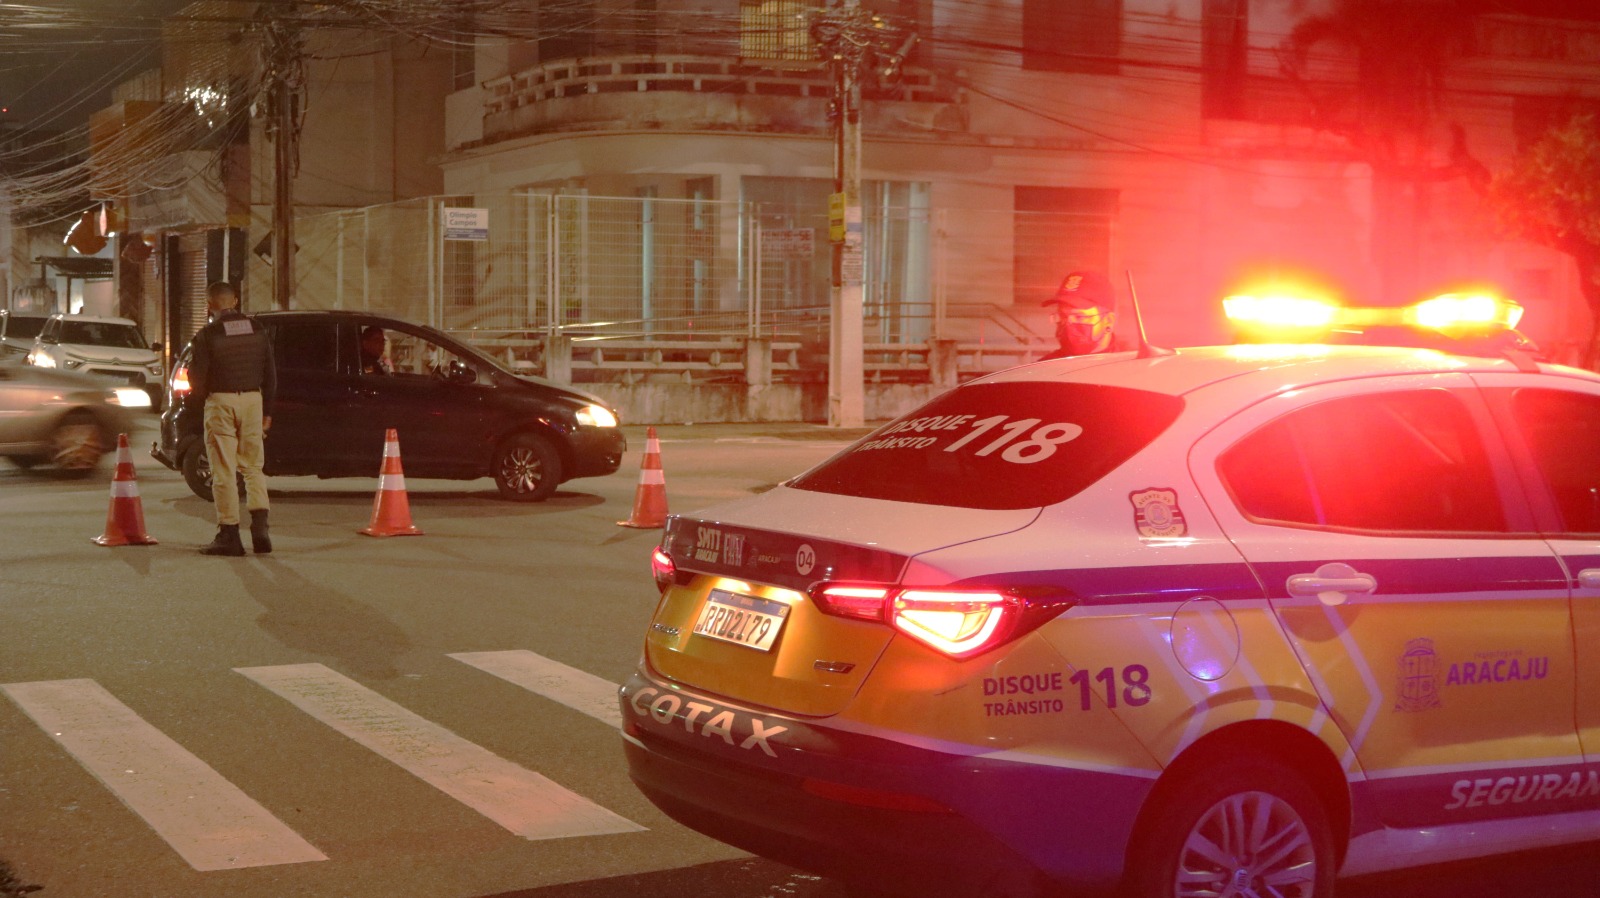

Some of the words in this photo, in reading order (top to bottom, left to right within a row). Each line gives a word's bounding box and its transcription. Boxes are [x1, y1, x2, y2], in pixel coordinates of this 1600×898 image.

[880, 414, 976, 436] DISQUE
[943, 415, 1083, 464] 118
[697, 526, 721, 551] SMTT
[799, 551, 813, 569] 04
[1445, 656, 1548, 686] ARACAJU
[983, 672, 1063, 696] DISQUE
[1069, 664, 1152, 711] 118
[631, 687, 788, 758] COTAX
[984, 699, 1064, 717] TRÂNSITO
